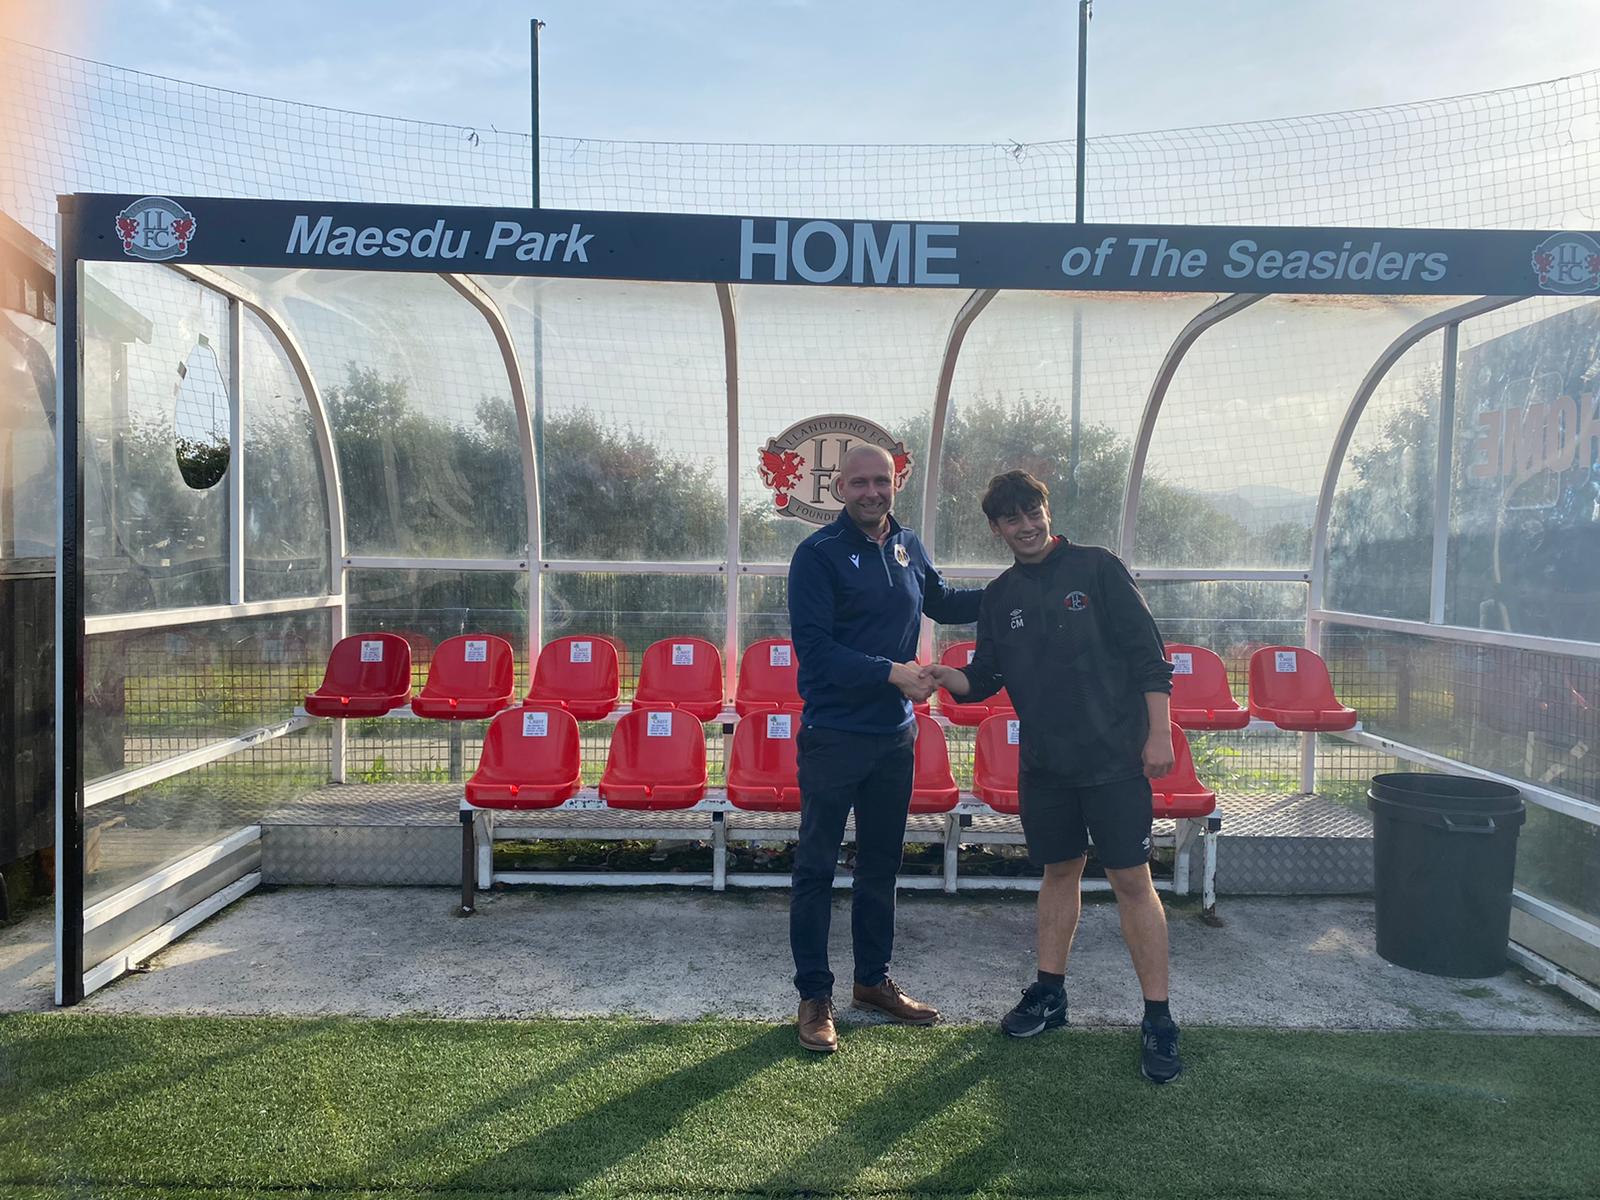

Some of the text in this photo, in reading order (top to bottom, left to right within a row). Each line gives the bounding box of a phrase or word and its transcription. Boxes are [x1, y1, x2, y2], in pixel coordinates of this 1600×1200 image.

[143, 210, 169, 231] LL
[143, 230, 170, 248] FC
[286, 215, 1449, 284] Maesdu Park HOME of The Seasiders
[786, 420, 888, 447] LLANDUDNO FC
[795, 503, 838, 521] FOUNDE
[1010, 619, 1024, 630] CM
